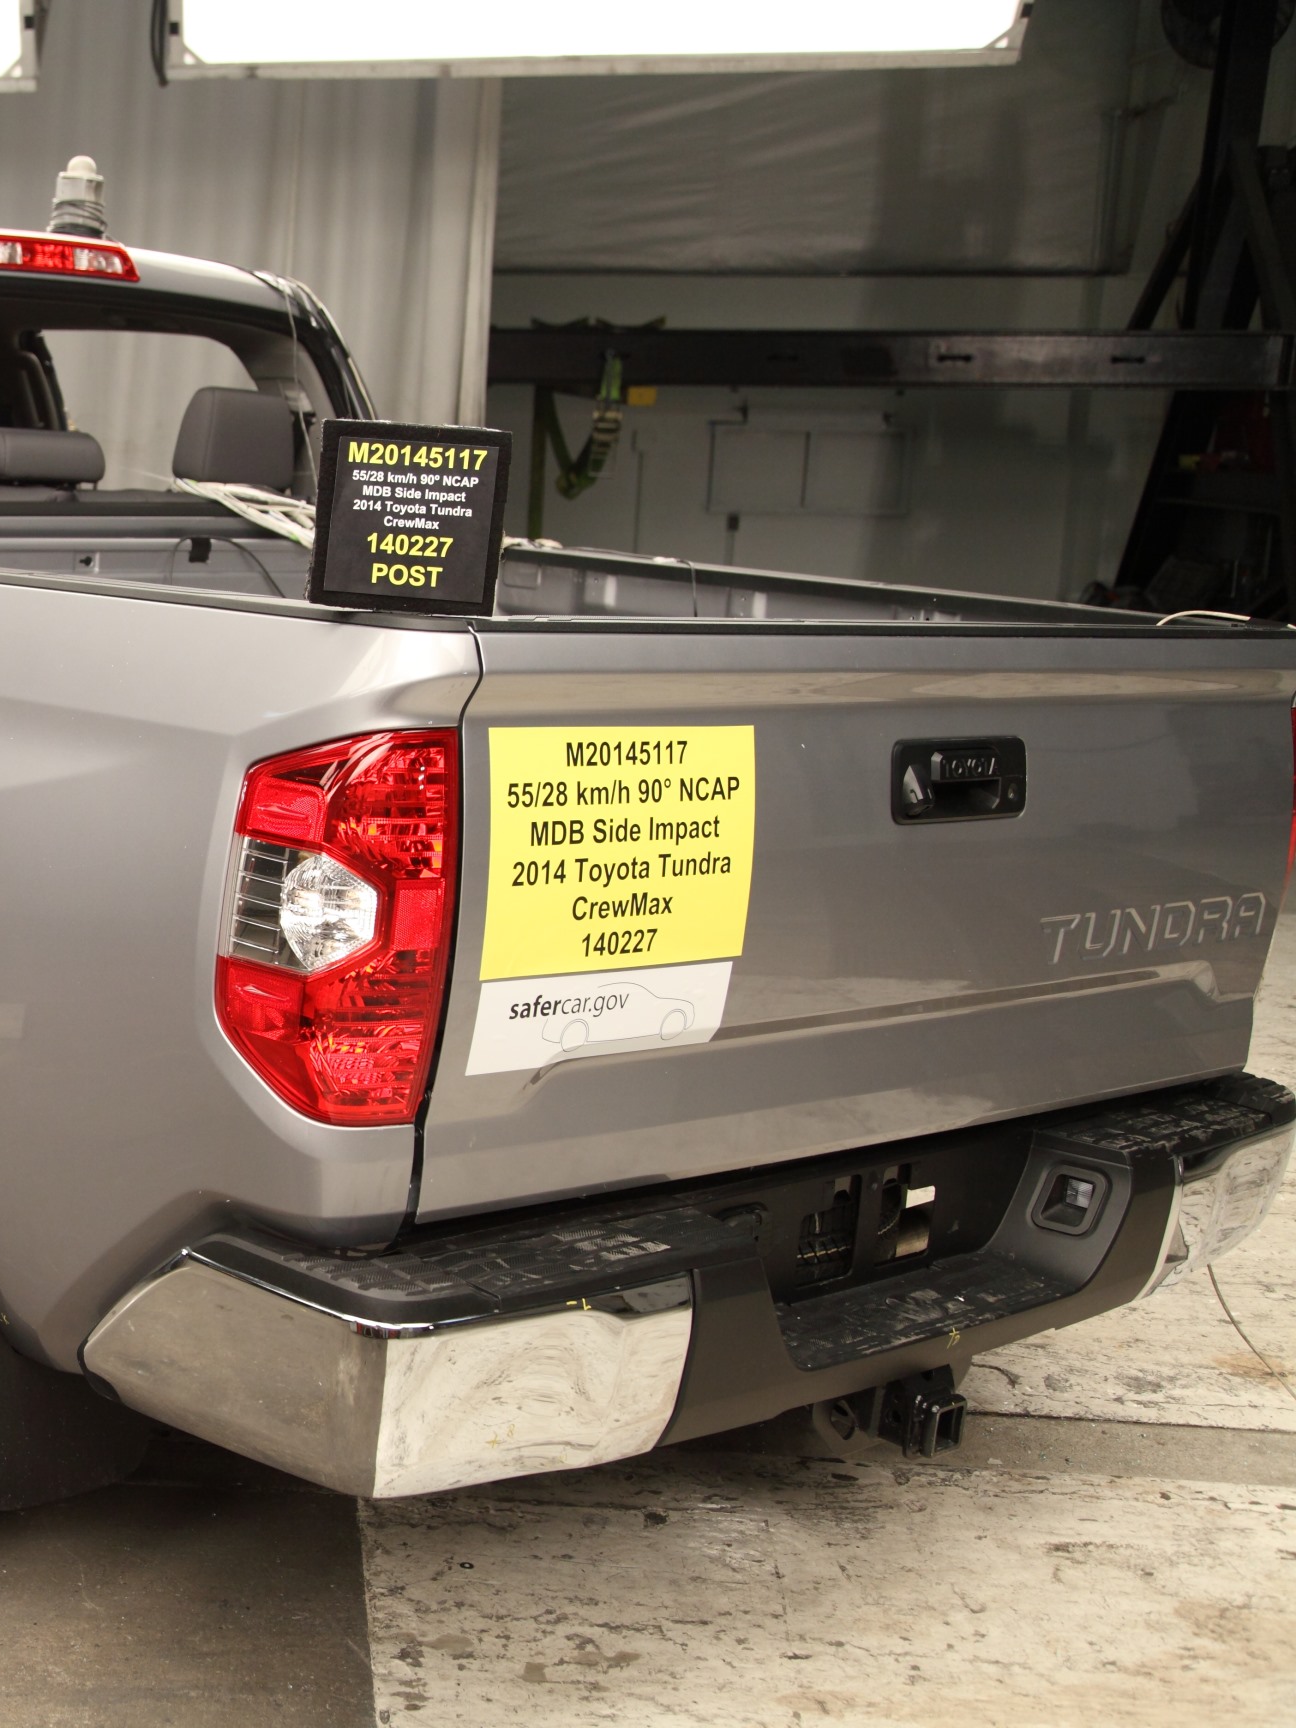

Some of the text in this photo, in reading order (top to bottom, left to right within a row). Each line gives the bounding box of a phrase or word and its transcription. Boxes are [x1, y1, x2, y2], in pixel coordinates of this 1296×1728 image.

[348, 441, 488, 471] M20145117
[352, 470, 385, 483] 55/28
[387, 472, 417, 485] km/h
[442, 475, 479, 488] NCAP
[362, 485, 466, 503] MDB Side Impact
[353, 499, 473, 517] 2014 Toyota Tundra
[383, 516, 440, 530] CrewMax
[367, 532, 454, 559] 140227
[371, 562, 443, 588] POST
[565, 740, 688, 767] M20145117
[942, 757, 1000, 778] TOYOTA
[507, 776, 740, 809] 55/28 km/h 90° NCAP
[530, 815, 720, 847] MDB Side Impact
[512, 851, 731, 888] 2014 Toyota Tundra
[572, 892, 674, 921] CrewMax
[1040, 891, 1268, 965] TUNDRA
[581, 928, 658, 957] 140227
[508, 992, 630, 1020] safercar.gov
